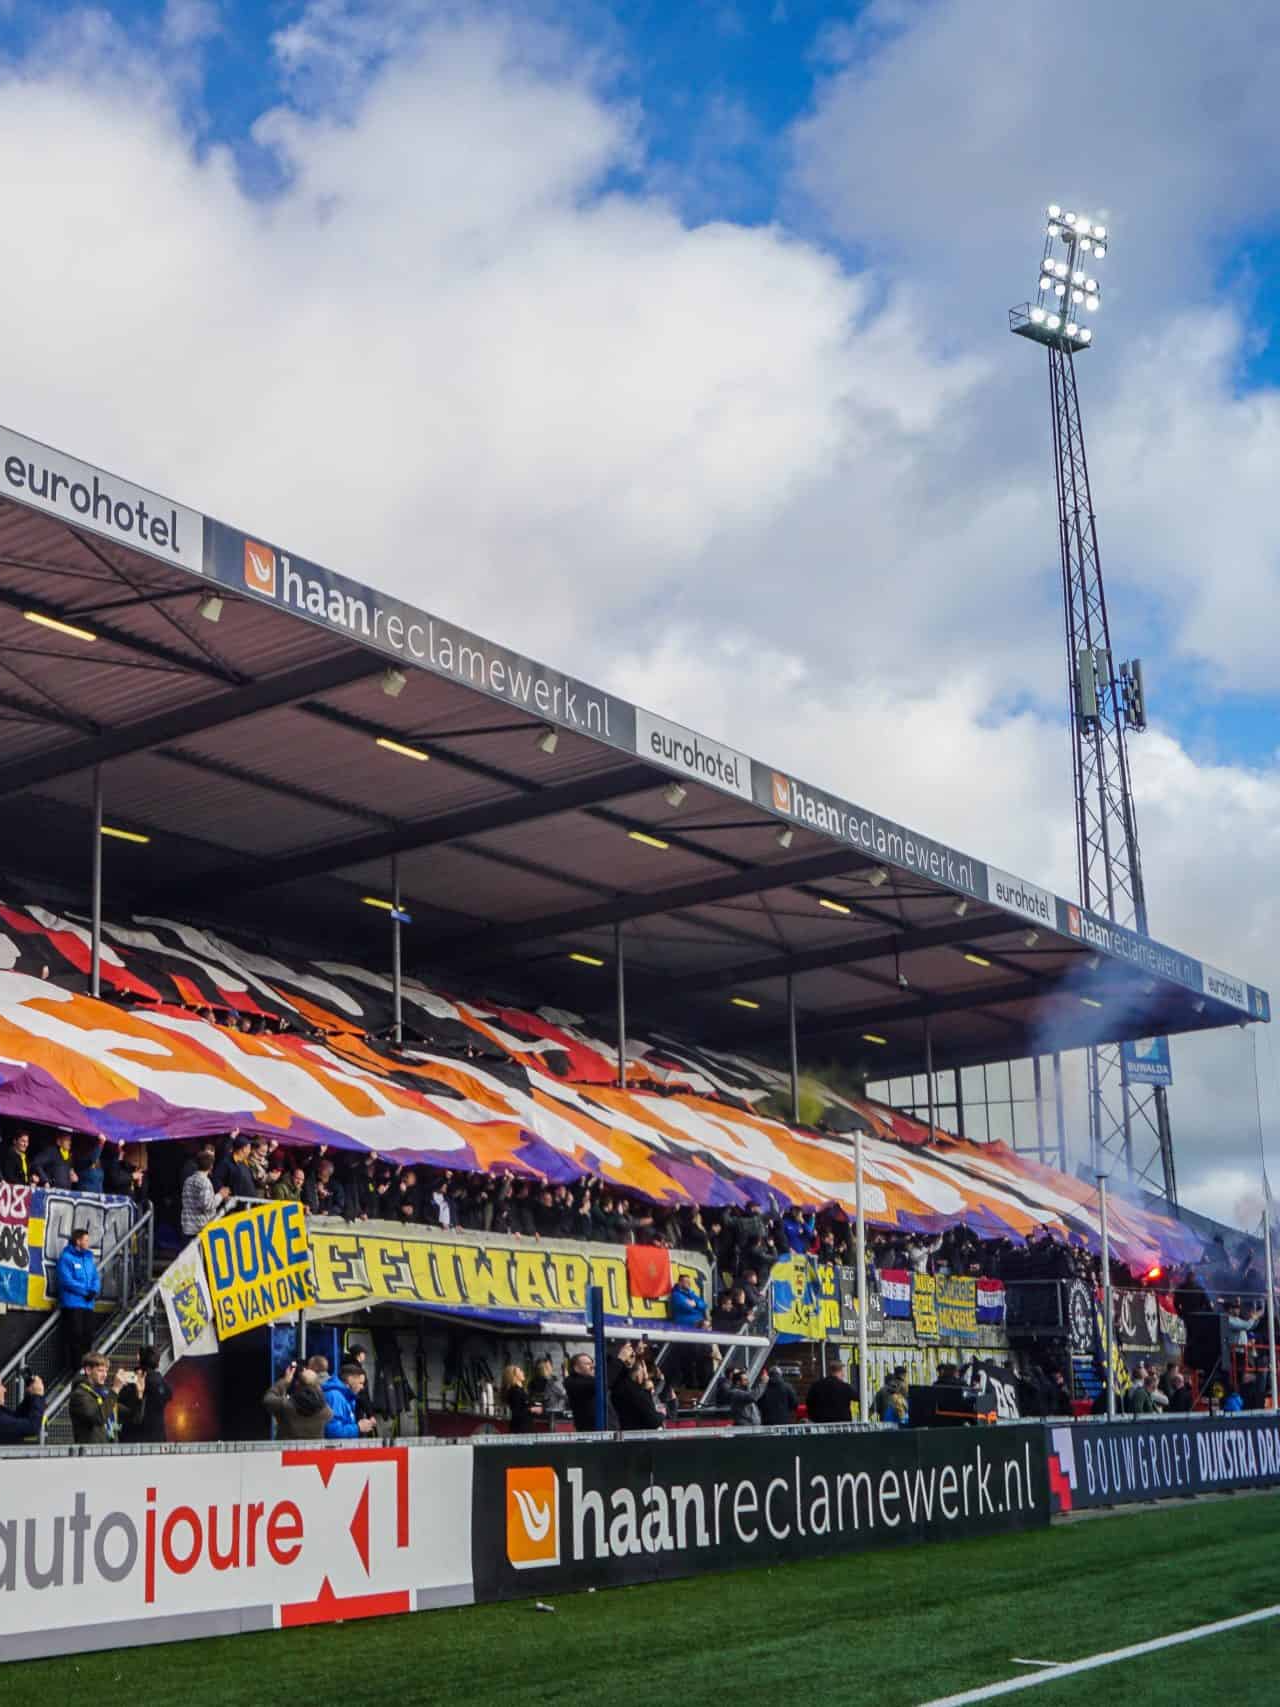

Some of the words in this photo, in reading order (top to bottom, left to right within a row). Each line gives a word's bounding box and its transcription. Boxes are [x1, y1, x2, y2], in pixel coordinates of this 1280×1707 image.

[4, 454, 180, 553] eurohotel
[650, 728, 740, 788] eurohotel
[995, 879, 1050, 921] eurohotel
[208, 1204, 309, 1291] DOKE
[218, 1296, 236, 1331] IS
[238, 1282, 275, 1322] VAN
[276, 1268, 317, 1308] ONS
[1083, 1433, 1192, 1496] BOUWGROEP
[1196, 1429, 1258, 1482] DIJKSTRA
[568, 1441, 1037, 1560] haanreclamewerk.nl
